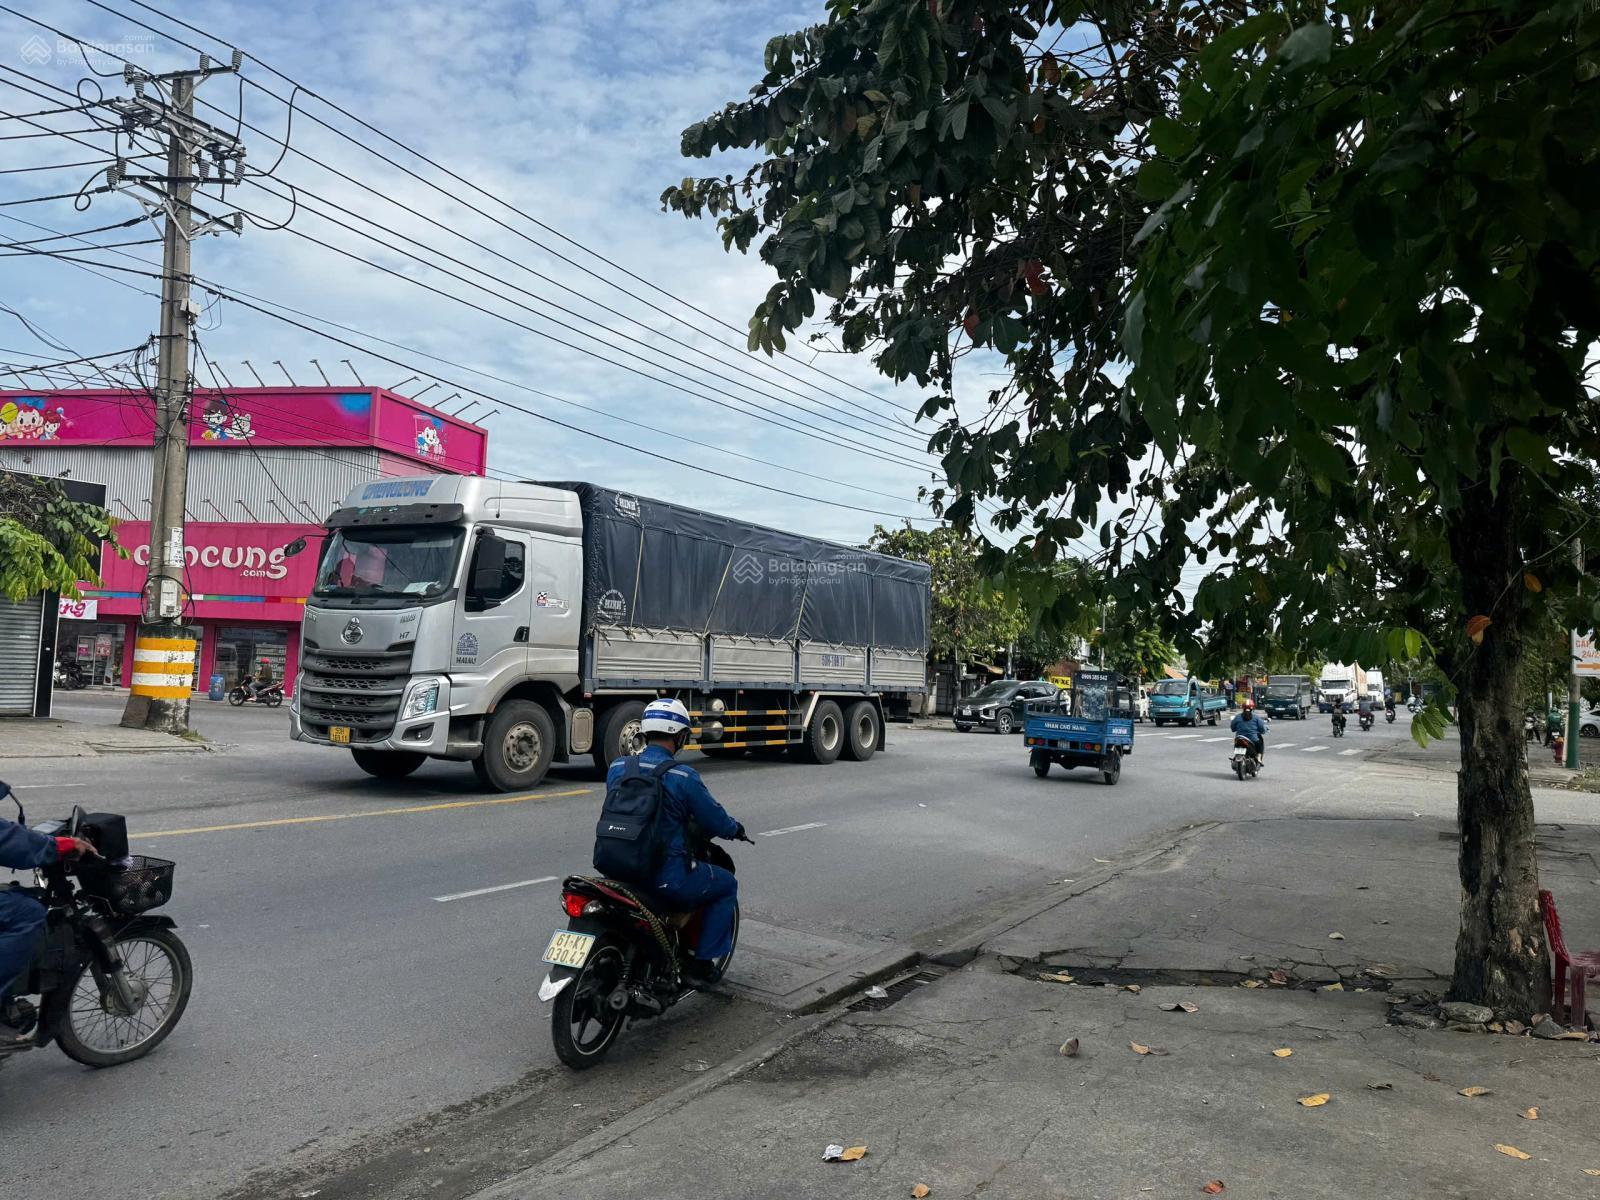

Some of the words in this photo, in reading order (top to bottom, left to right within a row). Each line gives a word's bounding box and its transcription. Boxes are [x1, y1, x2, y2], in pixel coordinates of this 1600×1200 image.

[133, 543, 288, 580] cncung
[399, 631, 410, 640] H7
[556, 933, 588, 950] 61-K1
[546, 946, 586, 965] 030.47
